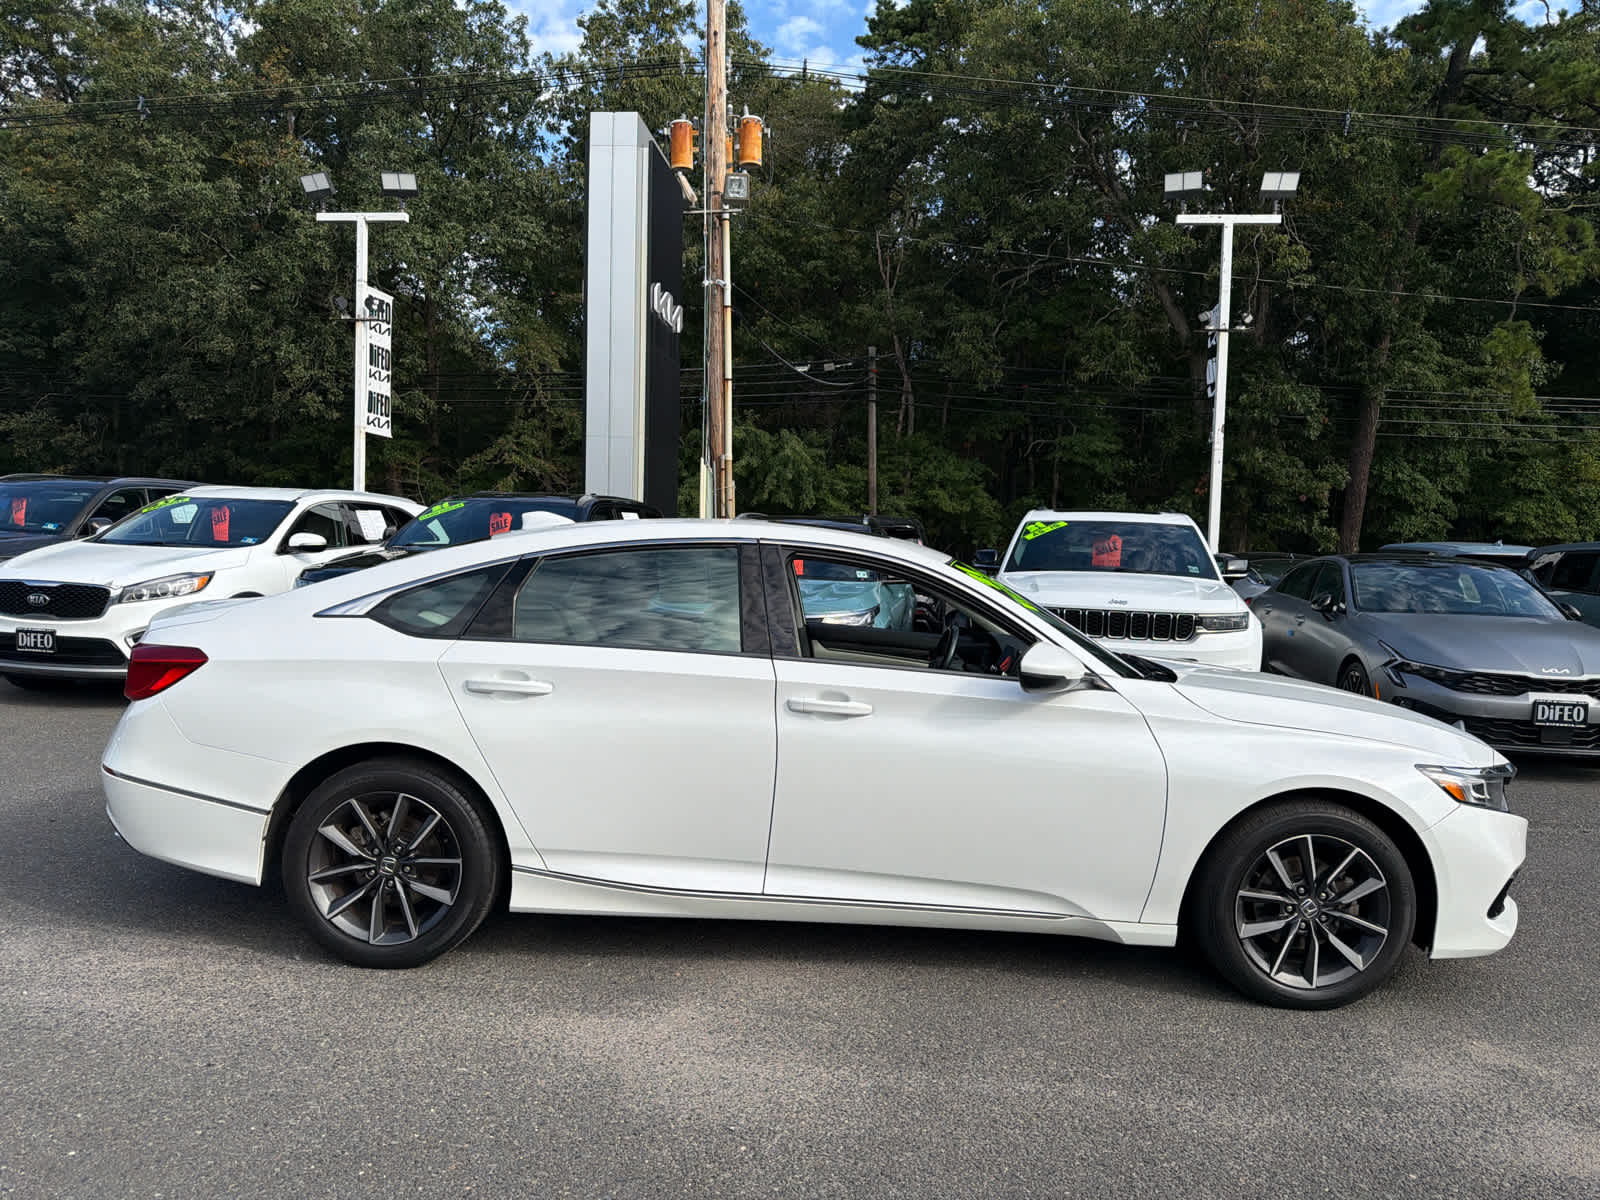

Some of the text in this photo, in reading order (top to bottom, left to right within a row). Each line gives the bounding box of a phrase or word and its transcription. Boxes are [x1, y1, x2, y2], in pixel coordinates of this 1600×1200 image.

[369, 343, 390, 371] DiFEO
[369, 367, 390, 383] KIA
[368, 390, 390, 418] DiFEO
[367, 415, 390, 429] KIA
[213, 510, 227, 526] SALE
[491, 518, 509, 532] SALE
[1095, 540, 1119, 556] SALE
[18, 631, 53, 649] DiFEO
[1537, 704, 1585, 722] DiFEO
